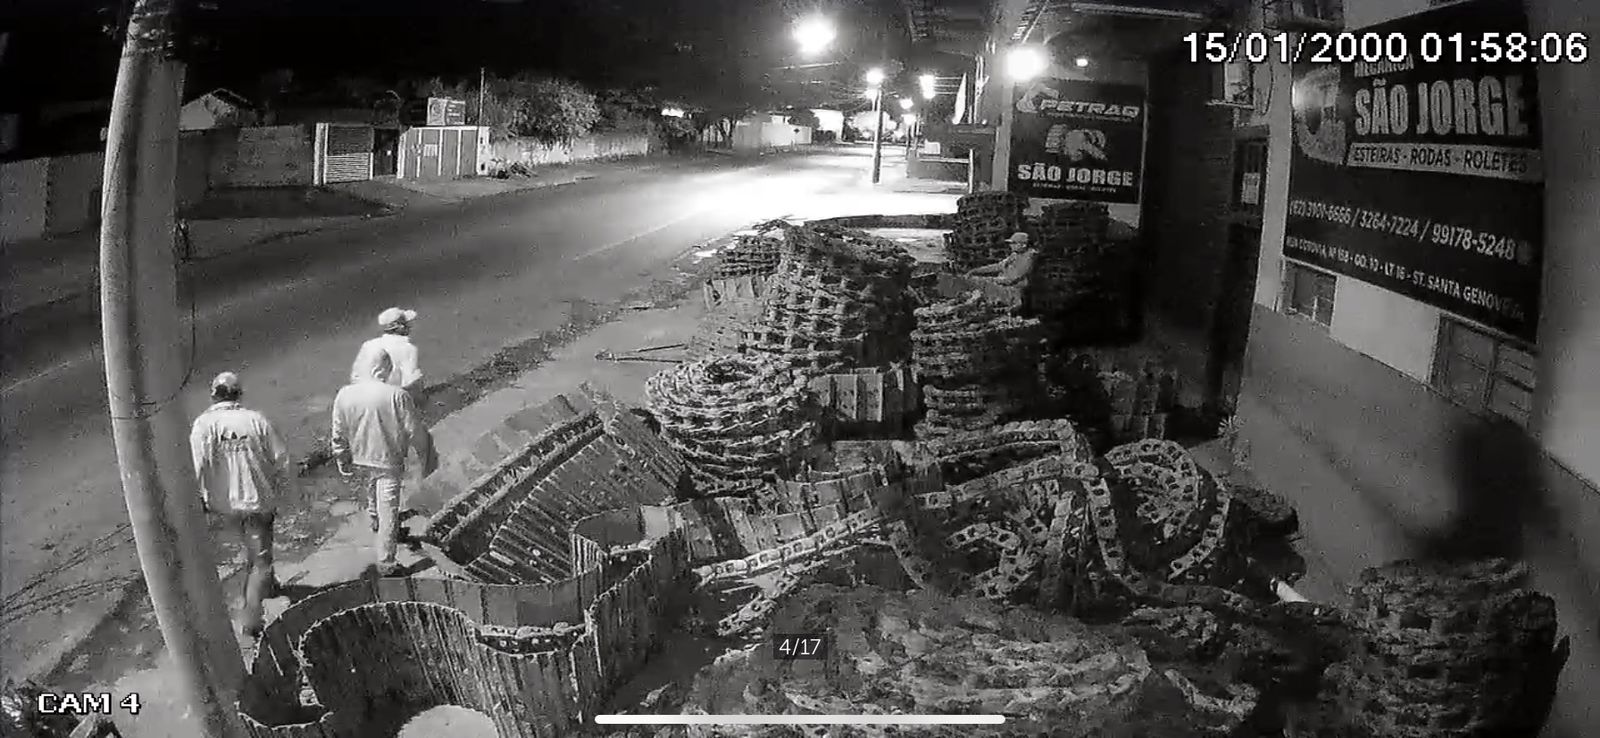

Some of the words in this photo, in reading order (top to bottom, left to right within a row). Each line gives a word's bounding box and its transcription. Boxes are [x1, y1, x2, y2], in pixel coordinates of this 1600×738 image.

[1355, 78, 1409, 135] SÃO
[1416, 75, 1529, 136] JORGE
[1354, 146, 1400, 163] ESTEIRAS
[1410, 148, 1451, 167] RODAS
[1463, 150, 1528, 173] ROLETES
[1017, 162, 1061, 181] SÃO
[1066, 167, 1133, 186] JORGE
[1360, 210, 1419, 237] 3264-7224
[1432, 223, 1516, 260] 99178-5248
[1427, 275, 1460, 298] SANTA
